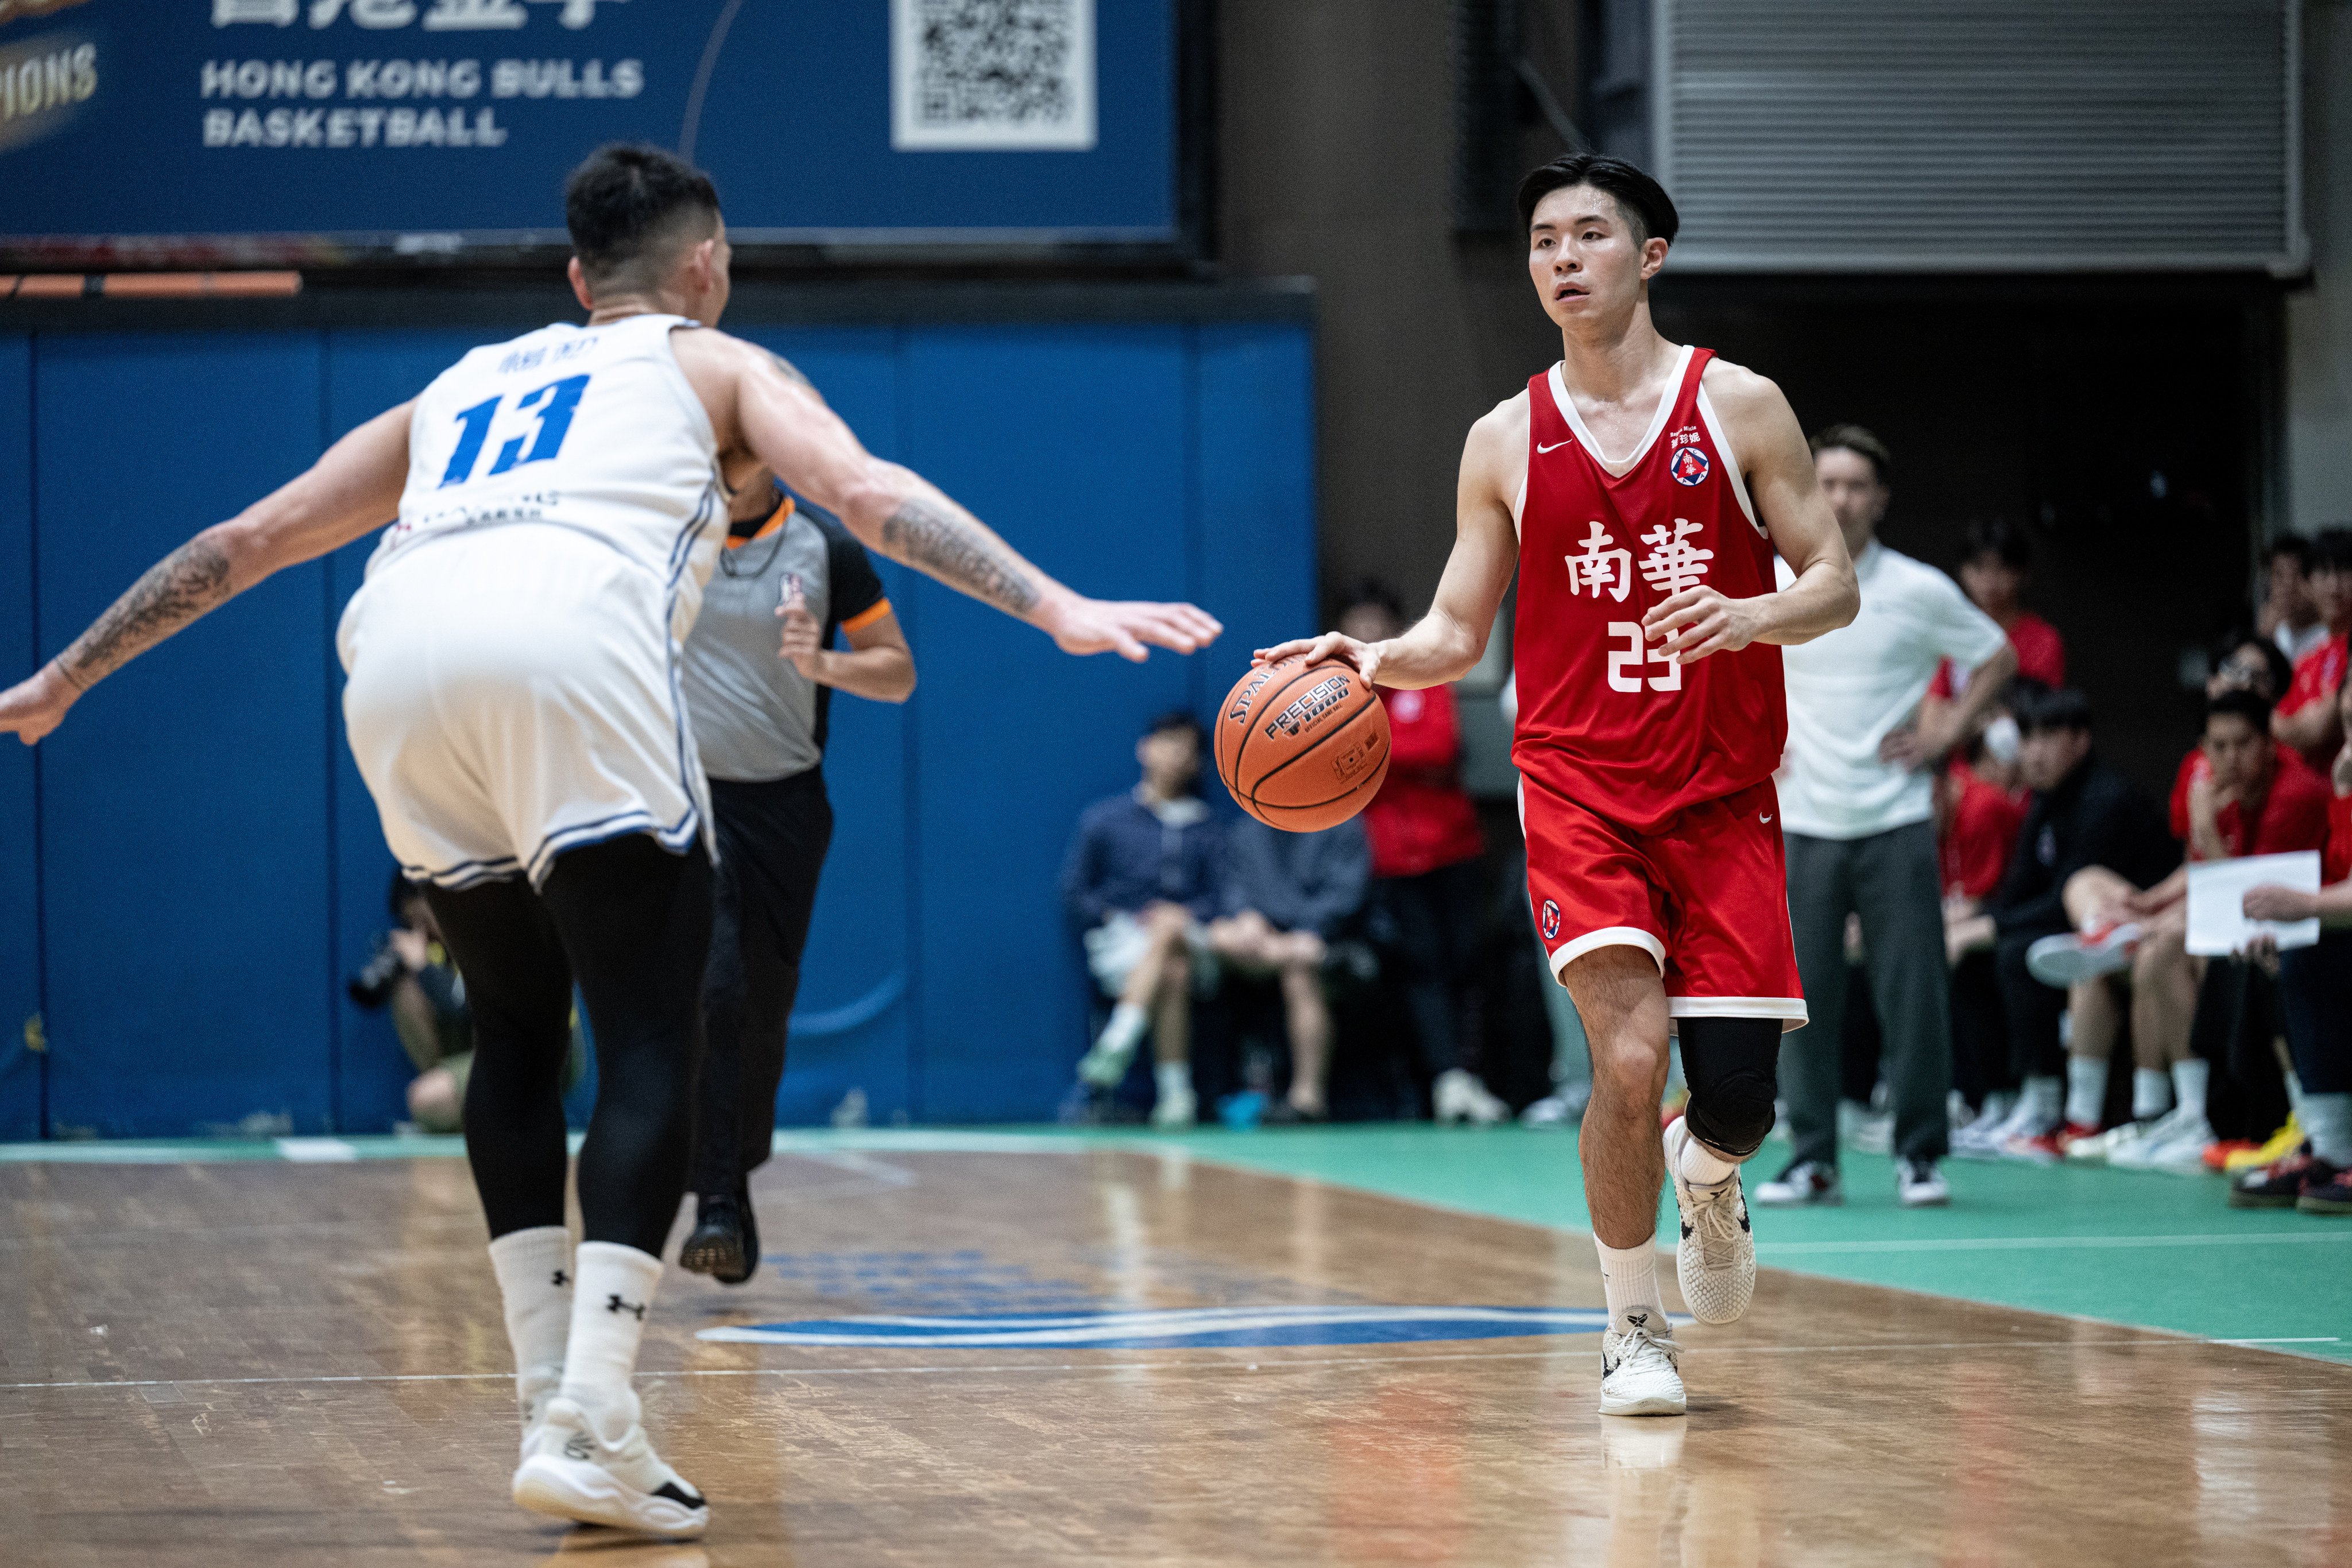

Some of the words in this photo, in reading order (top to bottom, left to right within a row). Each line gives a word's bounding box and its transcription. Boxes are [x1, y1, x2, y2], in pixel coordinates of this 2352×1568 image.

[201, 59, 337, 99] HONG
[346, 59, 481, 99] KONG
[491, 59, 645, 99] BULLS
[203, 107, 508, 148] BASKETBALL
[439, 373, 591, 489] 13
[1683, 453, 1696, 475] 南華
[1565, 518, 1714, 603] 南華
[1608, 621, 1681, 692] 23
[1264, 673, 1351, 740] PRECISION
[1302, 688, 1349, 722] 1000
[1305, 717, 1322, 733] OFFICIAL
[1322, 708, 1333, 719] GAME
